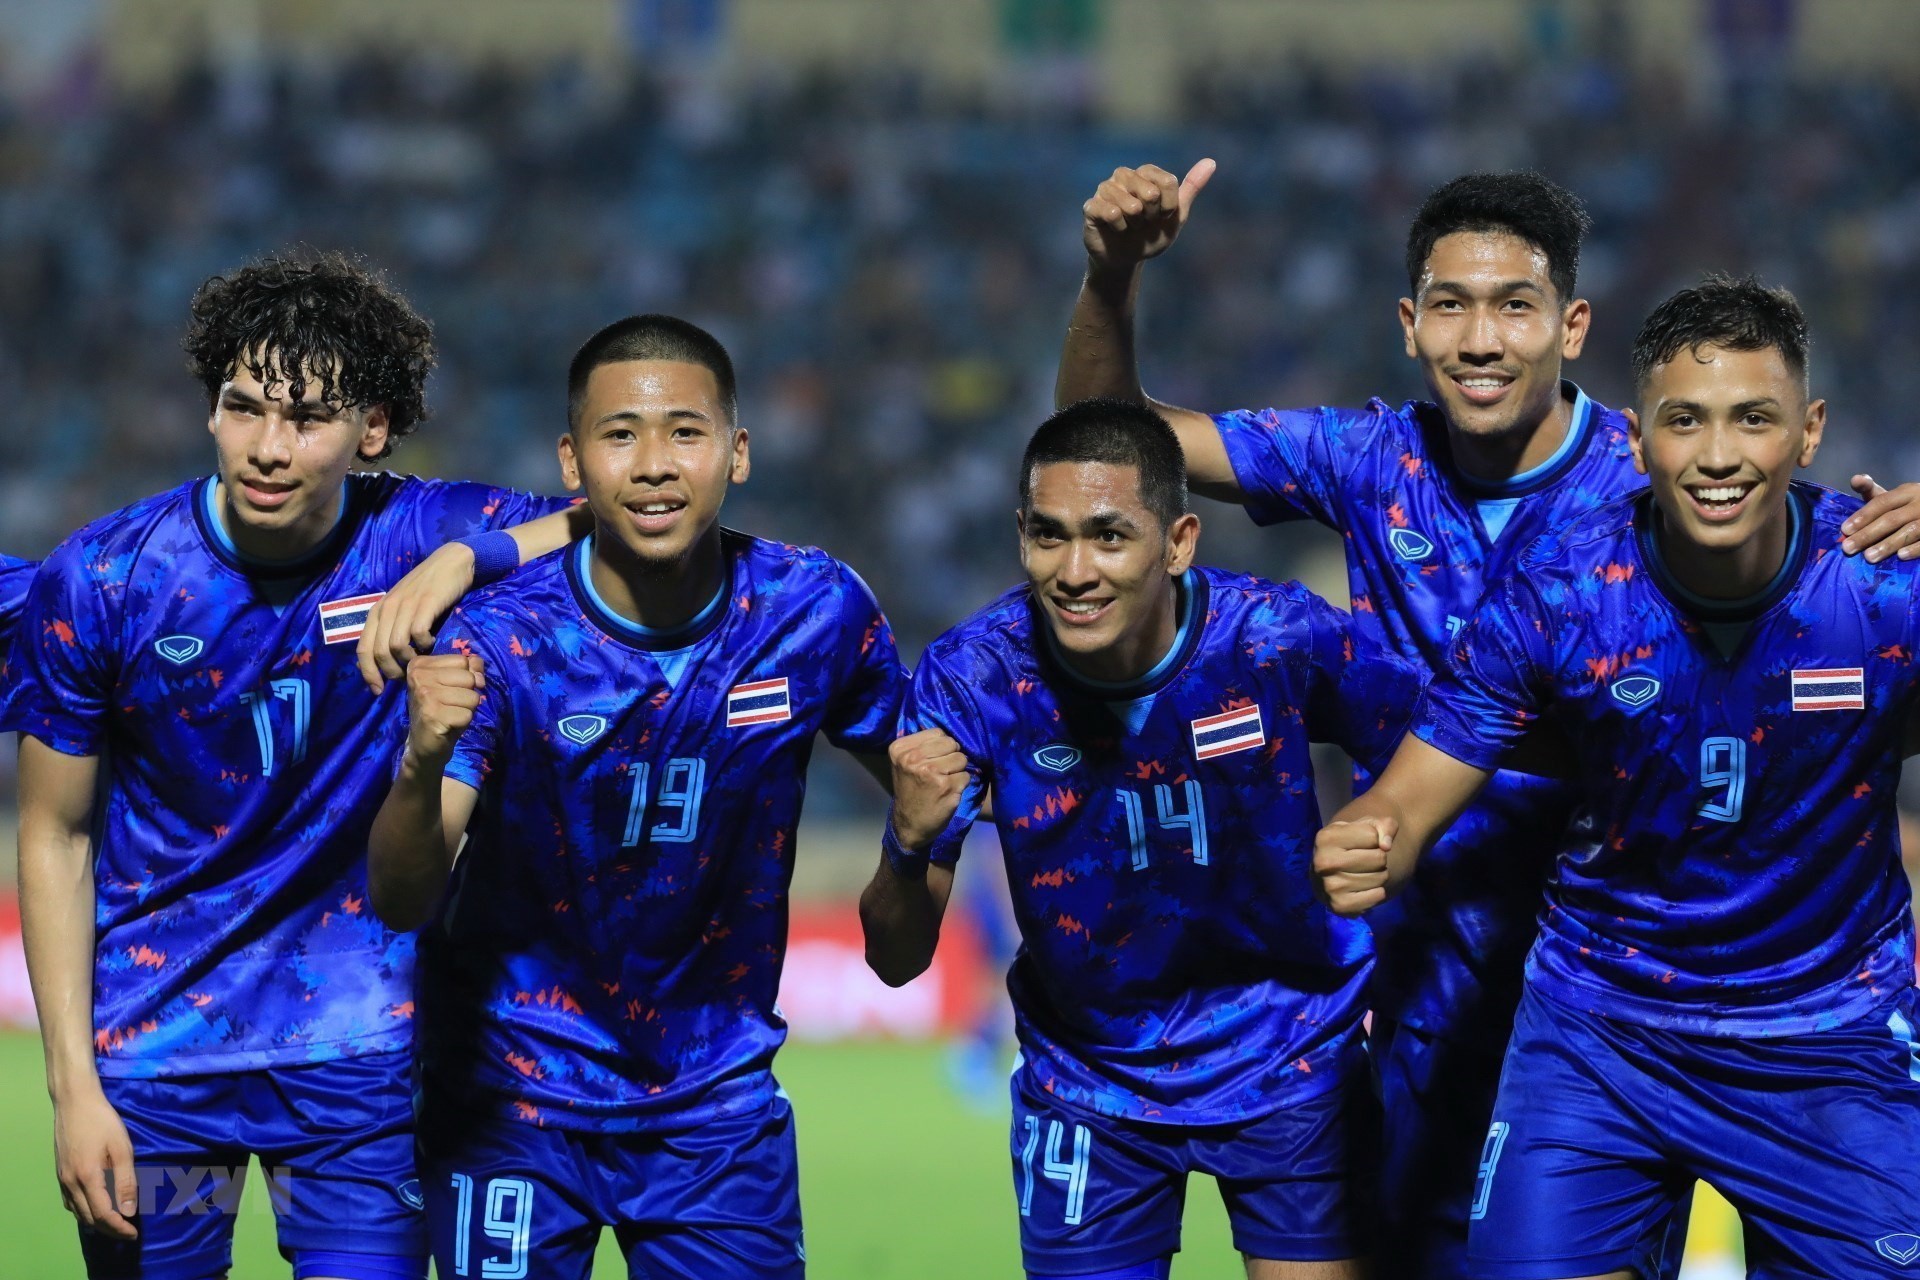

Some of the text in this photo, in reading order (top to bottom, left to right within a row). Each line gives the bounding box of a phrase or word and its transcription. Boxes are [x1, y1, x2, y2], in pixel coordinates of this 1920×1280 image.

[239, 678, 311, 777] 17
[621, 757, 706, 847] 19
[1115, 779, 1209, 872] 14
[1697, 736, 1746, 823] 9
[1021, 1115, 1091, 1225] 14
[451, 1172, 534, 1280] 19
